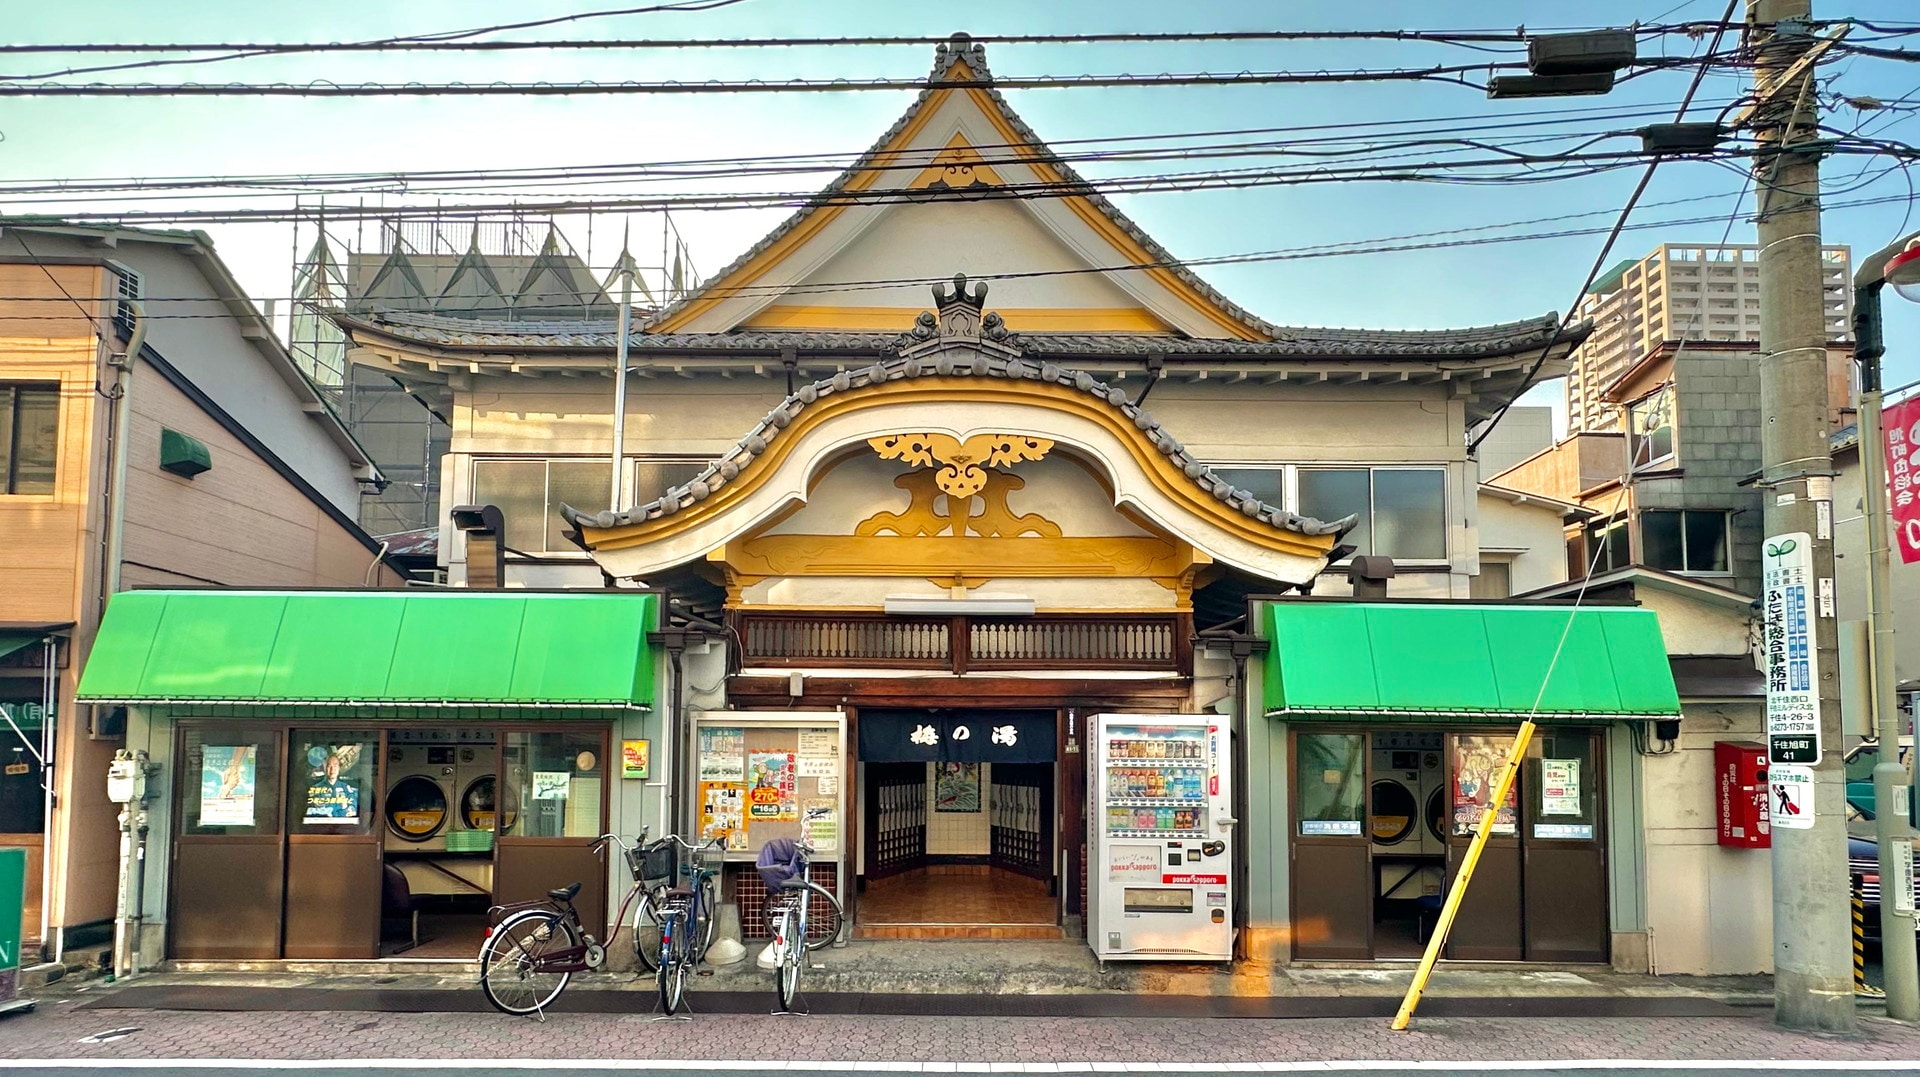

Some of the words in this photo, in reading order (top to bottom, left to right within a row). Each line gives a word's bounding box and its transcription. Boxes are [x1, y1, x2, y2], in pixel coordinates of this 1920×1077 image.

[1767, 590, 1787, 692] ふたば総合事務所
[1773, 740, 1810, 750] 千住旭町
[1782, 751, 1795, 760] 41
[786, 753, 796, 792] 敬老の日
